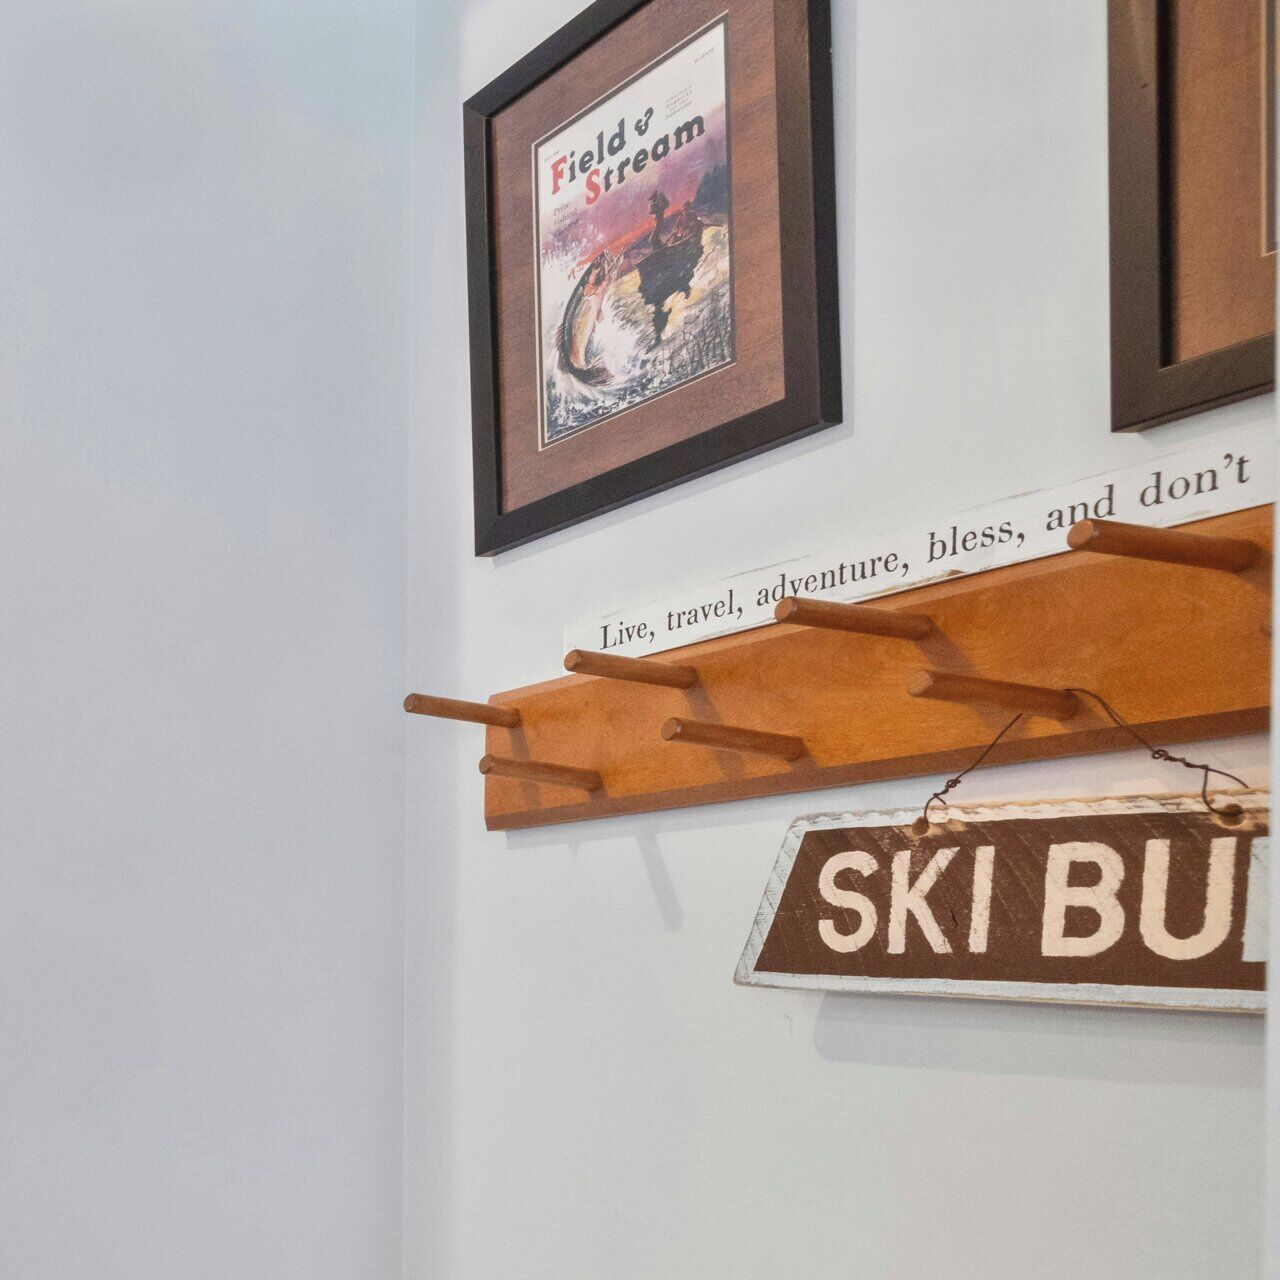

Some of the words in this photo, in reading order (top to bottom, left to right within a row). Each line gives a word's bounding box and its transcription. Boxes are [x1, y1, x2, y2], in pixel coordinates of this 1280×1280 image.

[551, 117, 627, 195] Field
[634, 106, 654, 137] &
[585, 115, 706, 206] Stream
[600, 622, 655, 651] Live,
[667, 589, 743, 631] travel,
[756, 552, 909, 607] adventure,
[927, 523, 1026, 563] bless,
[1045, 484, 1116, 532] and
[818, 845, 995, 954] SKI
